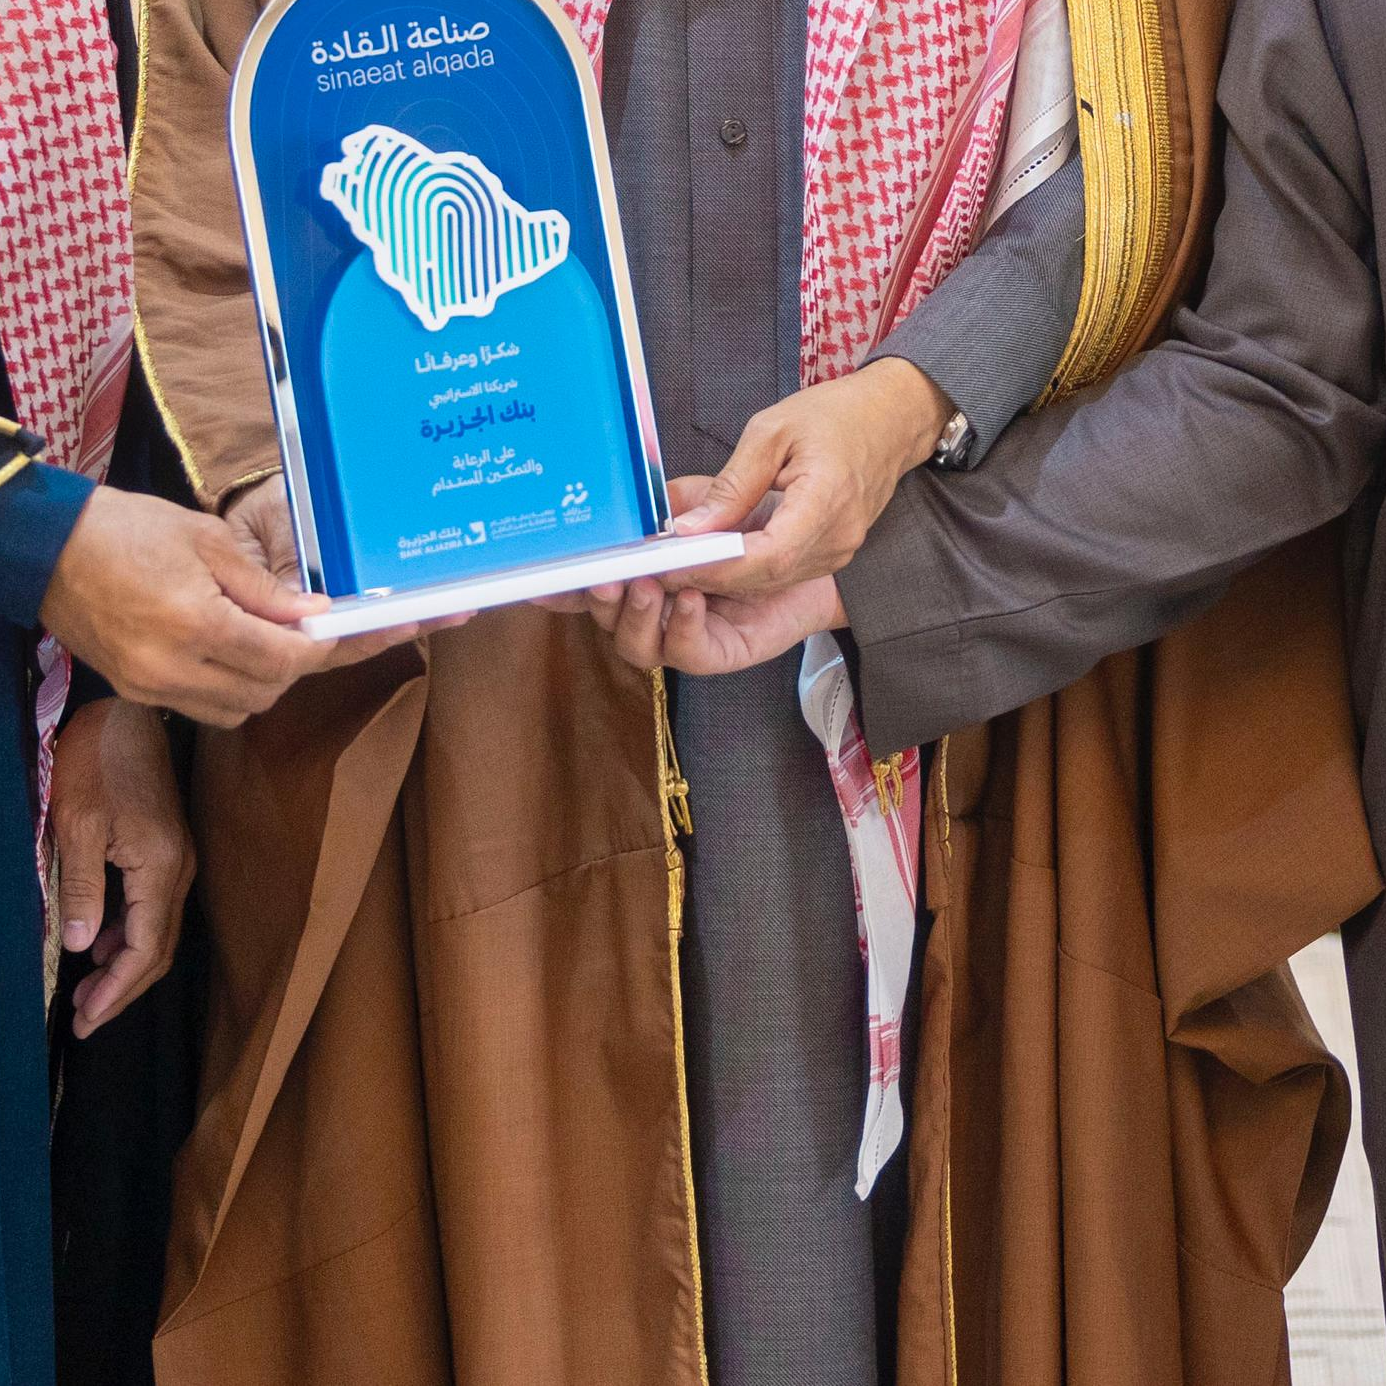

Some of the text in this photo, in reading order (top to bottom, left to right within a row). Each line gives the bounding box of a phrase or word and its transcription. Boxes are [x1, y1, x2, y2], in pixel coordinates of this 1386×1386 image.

[311, 15, 490, 65] صناعة القادة
[316, 44, 495, 93] sinaeat alqada
[421, 399, 536, 442] بنك الجزيرة
[452, 446, 516, 471] على الرعاية
[486, 458, 545, 484] والتمكين
